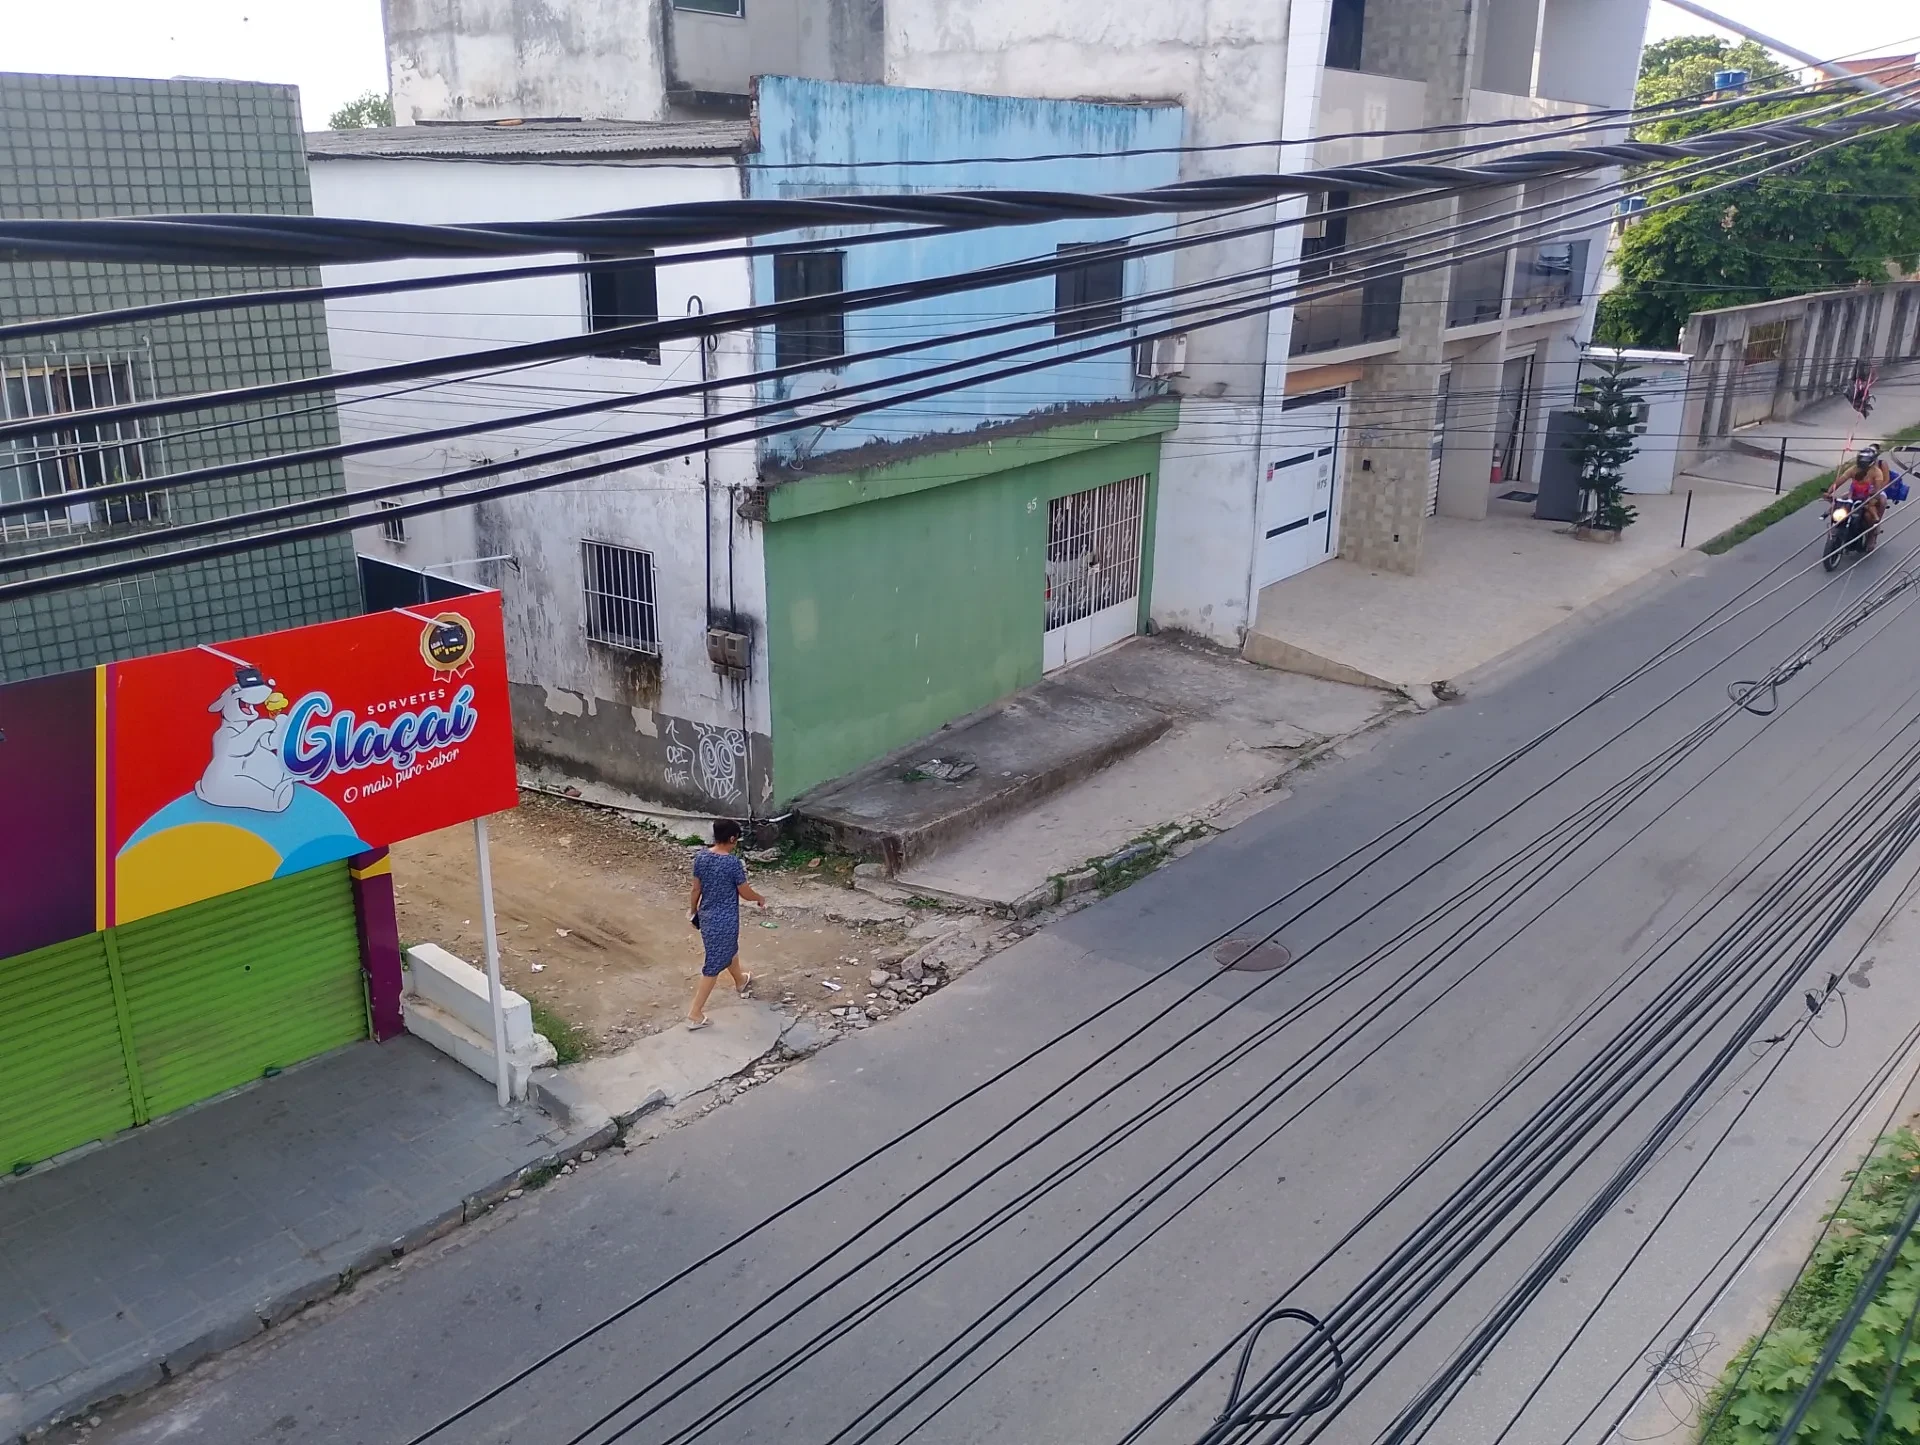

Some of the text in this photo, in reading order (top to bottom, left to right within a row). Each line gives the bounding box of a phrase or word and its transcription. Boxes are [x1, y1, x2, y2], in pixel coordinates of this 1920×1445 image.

[1026, 496, 1038, 514] 95
[367, 688, 446, 715] SORVETES
[283, 687, 476, 780] Glaçaí
[343, 748, 460, 803] O mais puro sabor
